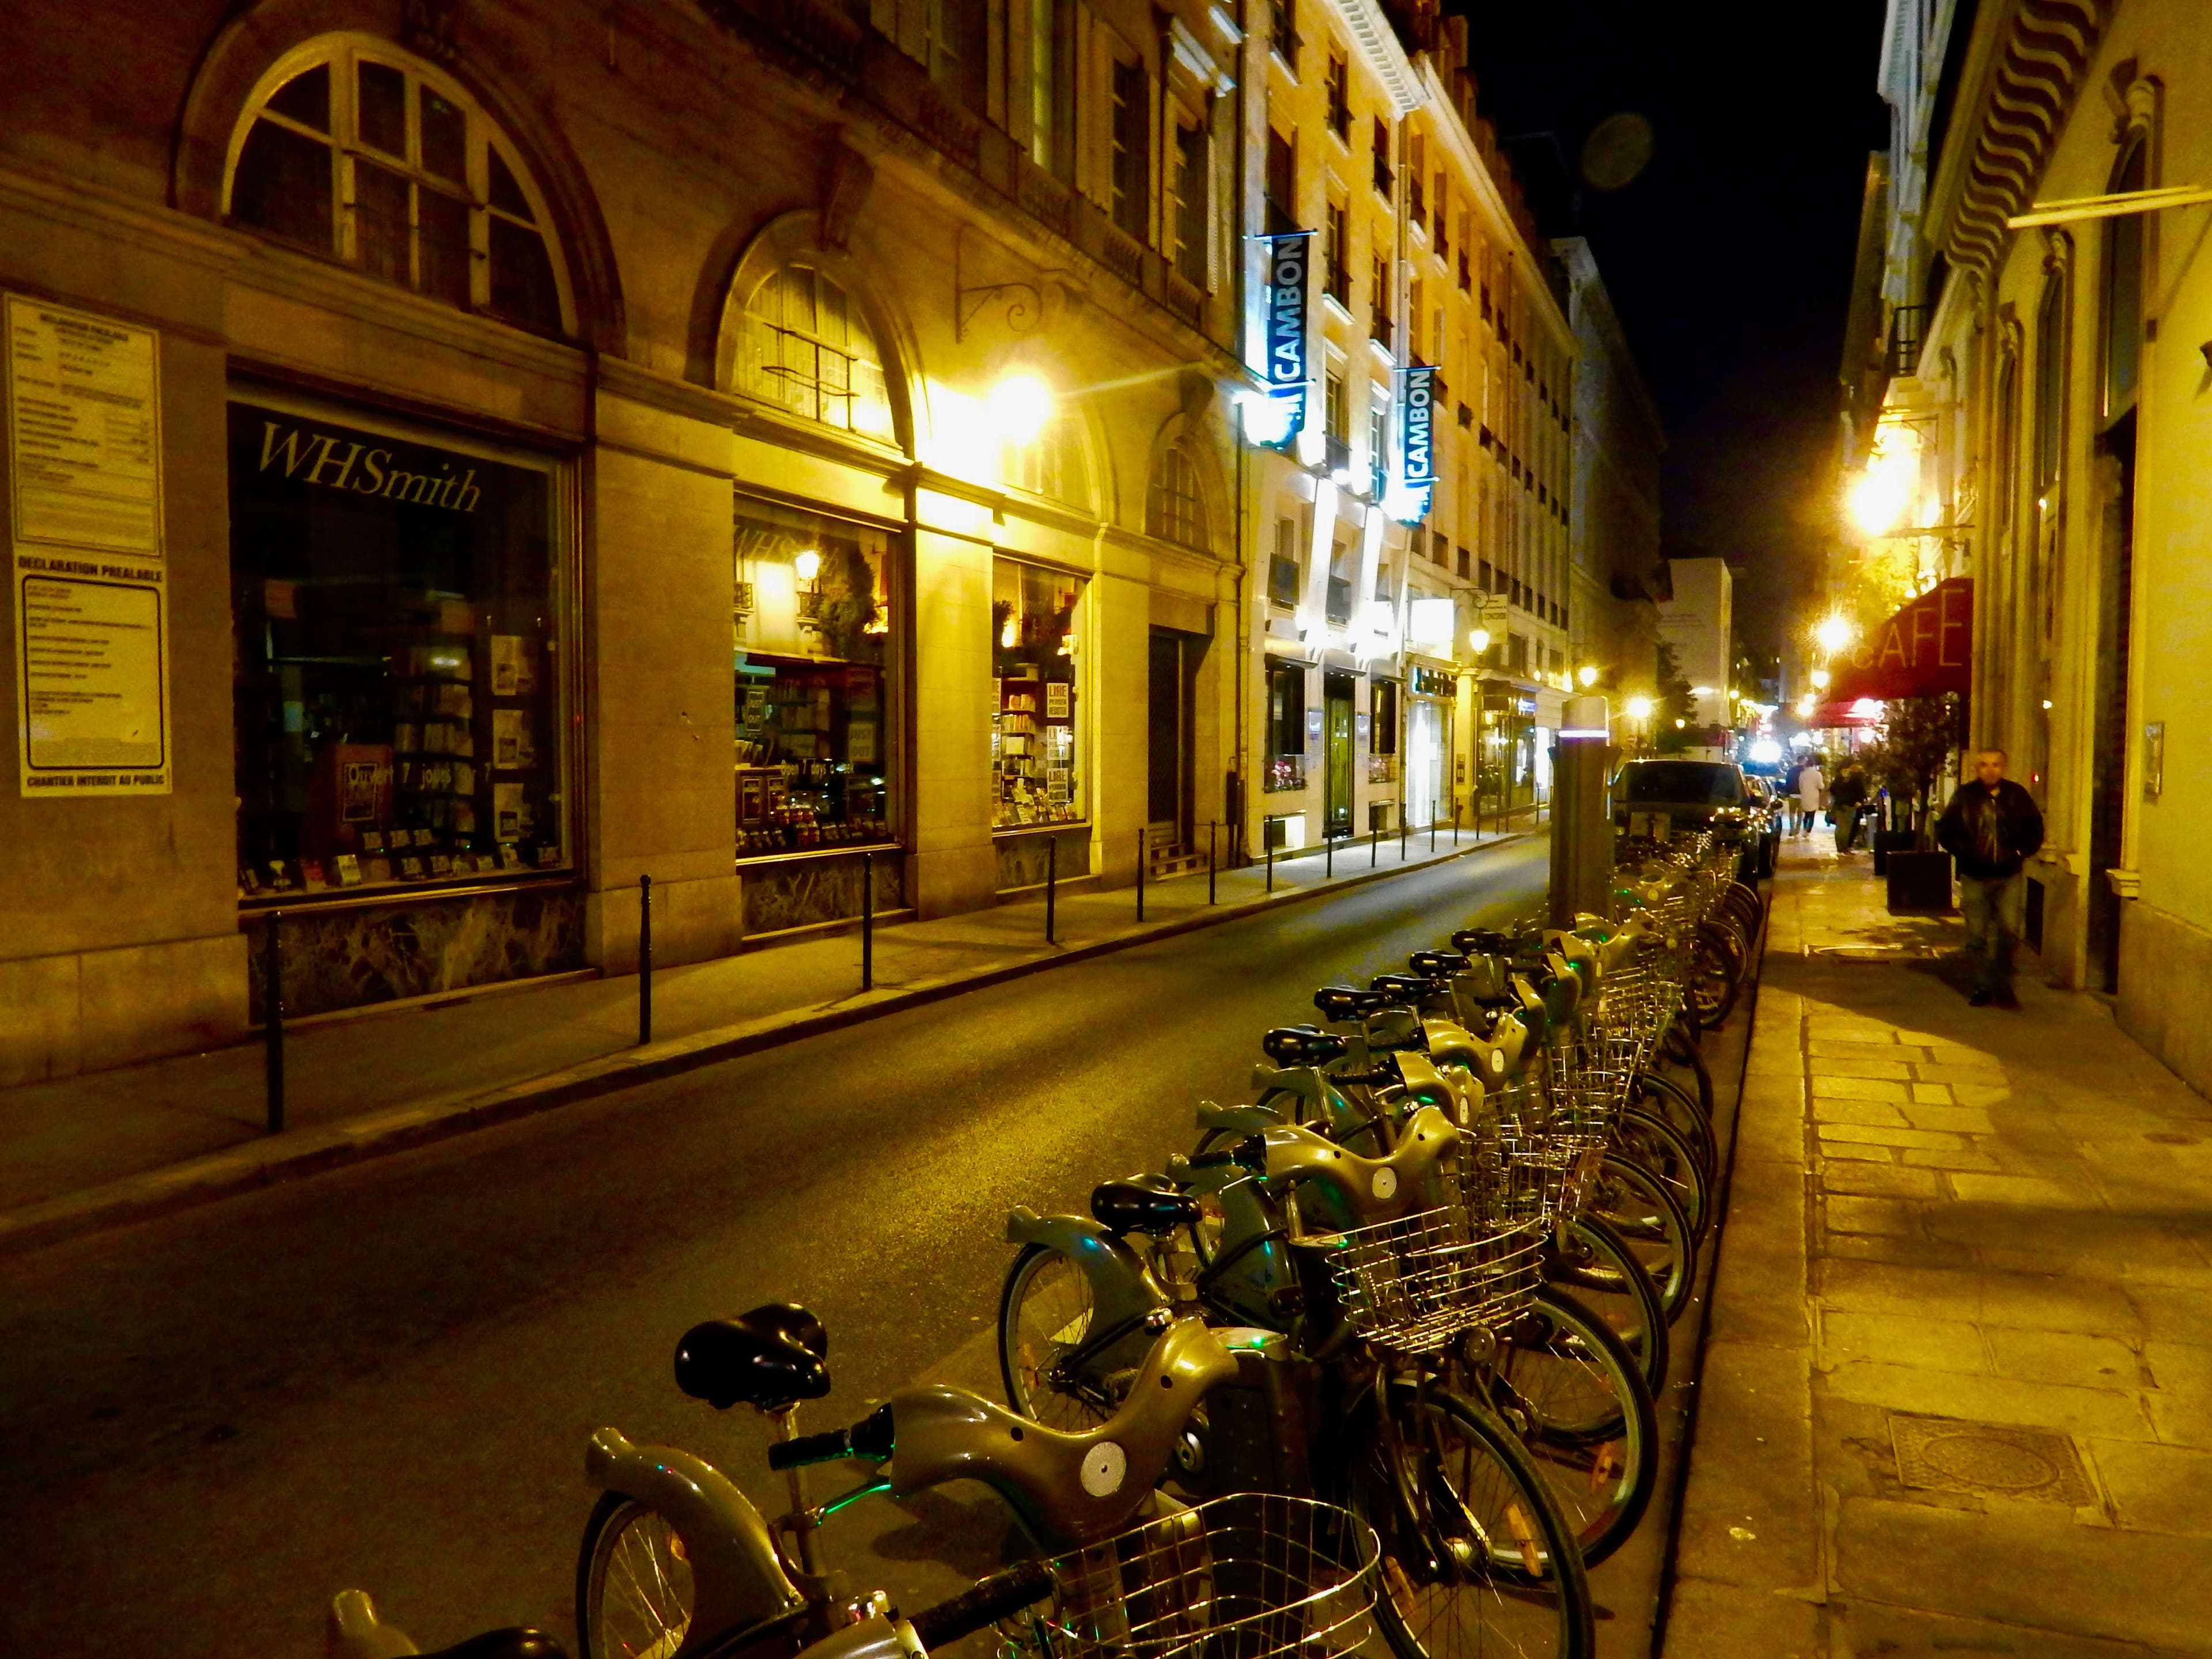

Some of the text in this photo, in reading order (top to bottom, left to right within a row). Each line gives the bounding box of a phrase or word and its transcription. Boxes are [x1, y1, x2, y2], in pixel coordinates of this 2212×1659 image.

[1274, 238, 1302, 382] CAMBON
[259, 421, 481, 513] WHSmith
[1408, 370, 1430, 478] CAMBON
